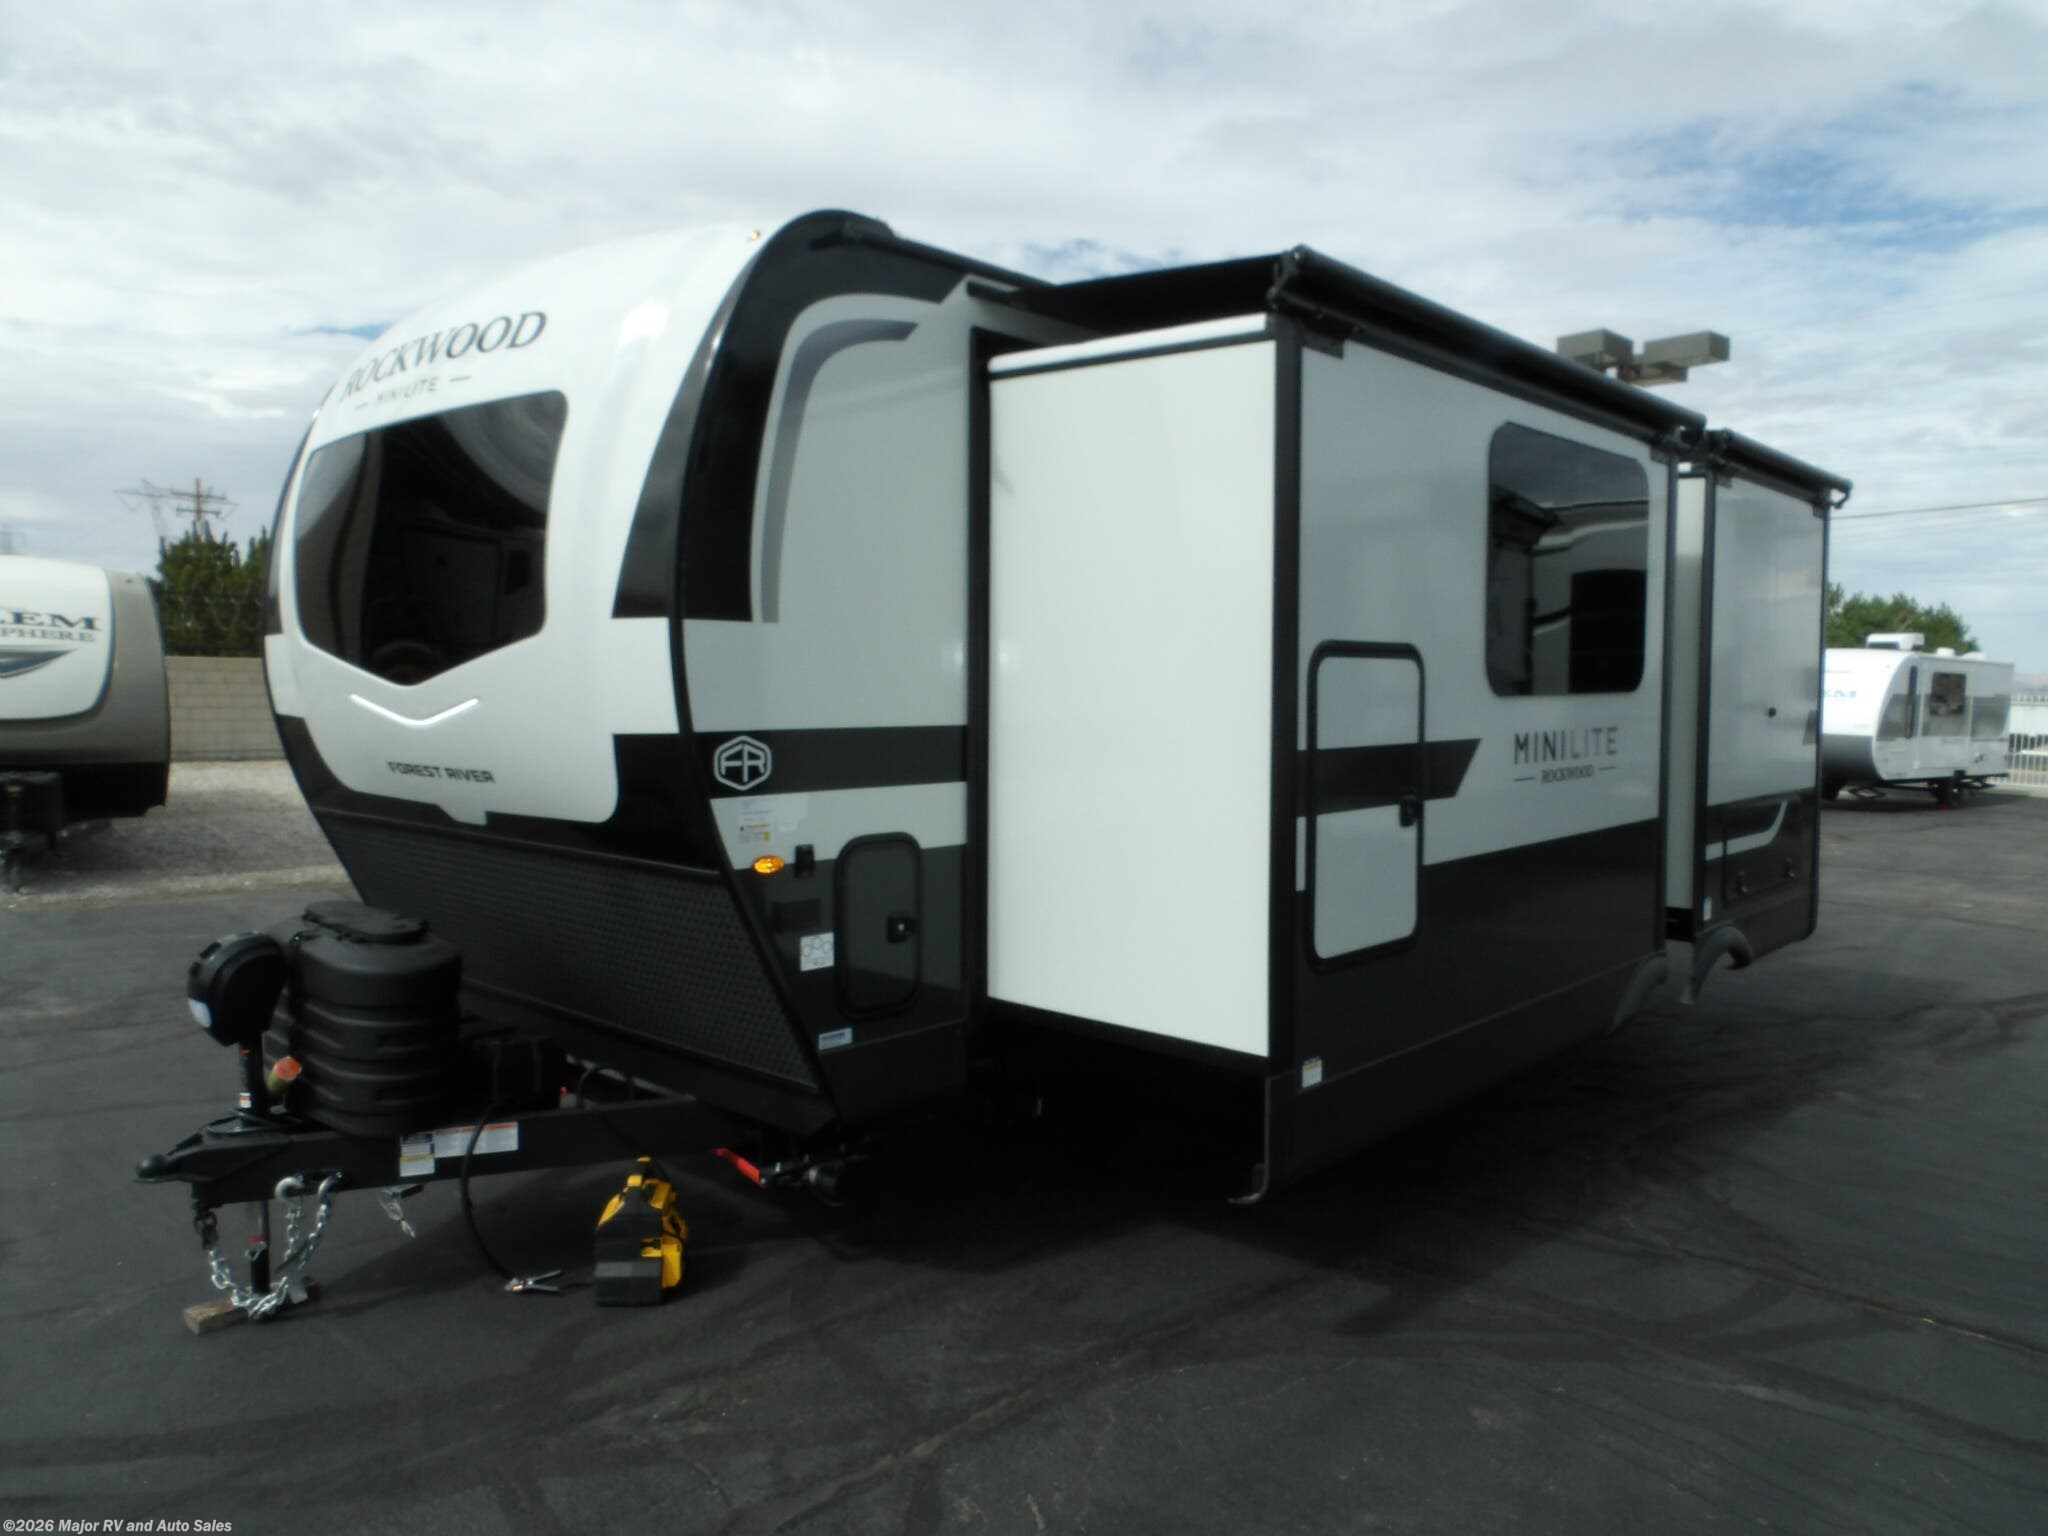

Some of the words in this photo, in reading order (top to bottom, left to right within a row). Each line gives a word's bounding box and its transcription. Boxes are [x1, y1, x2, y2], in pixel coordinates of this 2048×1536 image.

[340, 311, 548, 402] ROCKWOOD
[376, 376, 440, 404] MINILITE
[1514, 725, 1618, 766] MINILITE
[387, 761, 442, 780] FOREST
[445, 767, 496, 784] RIVER
[1541, 764, 1595, 784] ROCKWOOD
